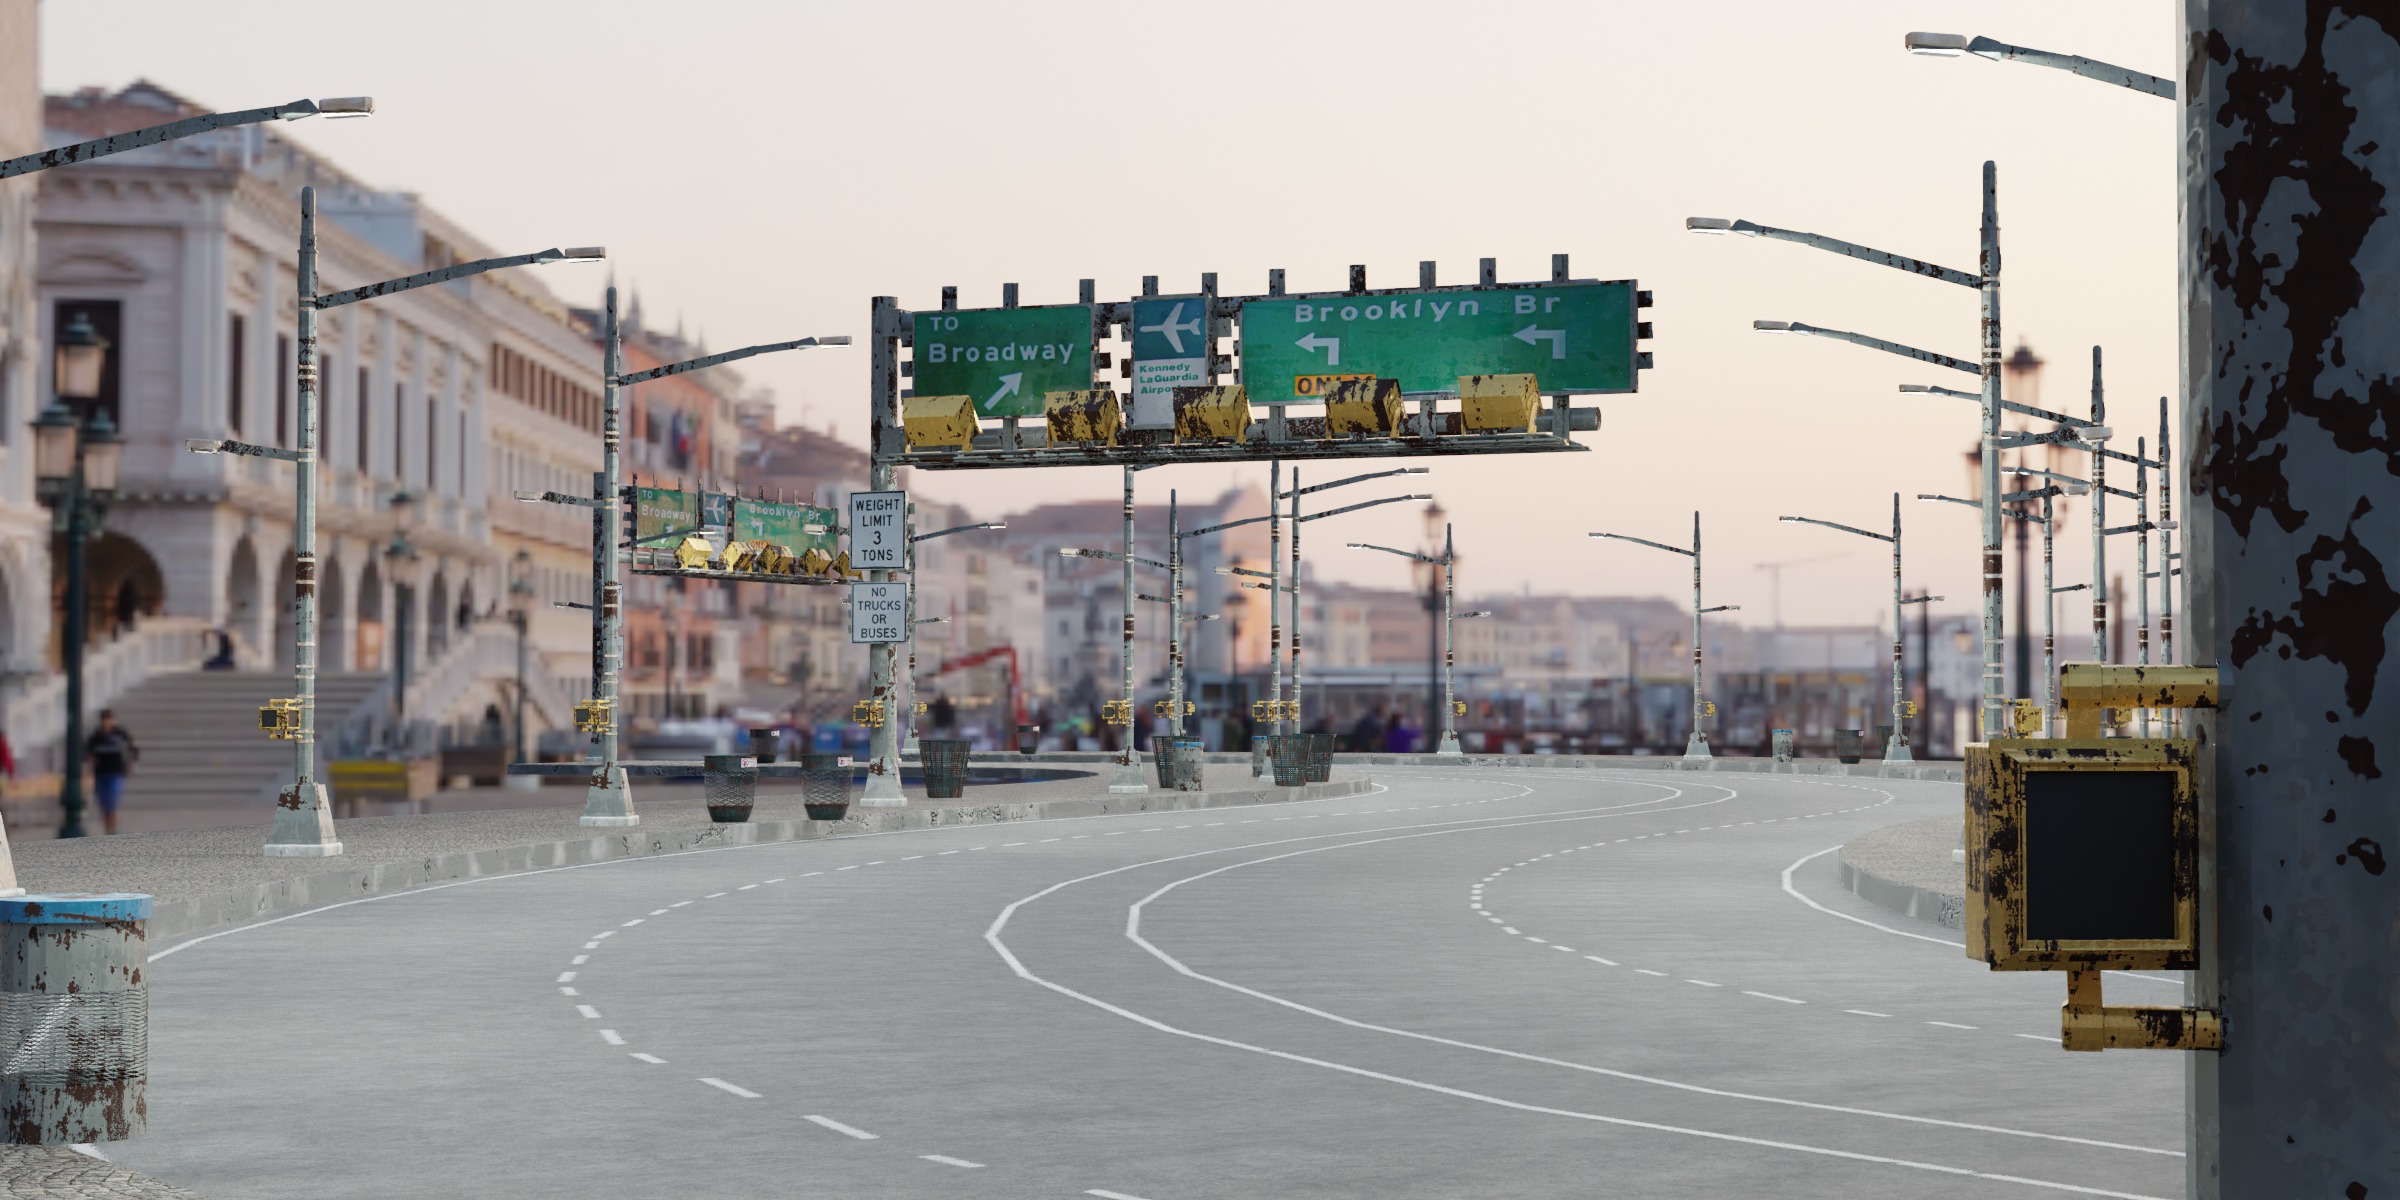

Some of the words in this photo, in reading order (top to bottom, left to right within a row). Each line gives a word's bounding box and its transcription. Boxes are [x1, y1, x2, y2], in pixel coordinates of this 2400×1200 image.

[1295, 298, 1479, 323] Brooklyn
[1514, 294, 1561, 315] Br
[929, 316, 959, 331] TO
[928, 343, 1075, 365] Broadway
[1139, 363, 1191, 373] Kennedy
[1140, 373, 1199, 384] LaGuardia
[1140, 385, 1181, 395] Airpo
[1297, 376, 1373, 395] ON
[642, 490, 653, 499] TO
[749, 503, 801, 520] Brooklyn
[808, 510, 821, 521] Br
[856, 499, 900, 512] WEIGHT
[641, 504, 691, 523] Broadway
[862, 514, 893, 527] LIMIT
[872, 530, 882, 546] 3
[862, 549, 893, 562] TONS
[871, 587, 887, 597] NO
[858, 600, 901, 611] TRUCKS
[871, 614, 887, 624] OR
[860, 628, 897, 639] BUSES
